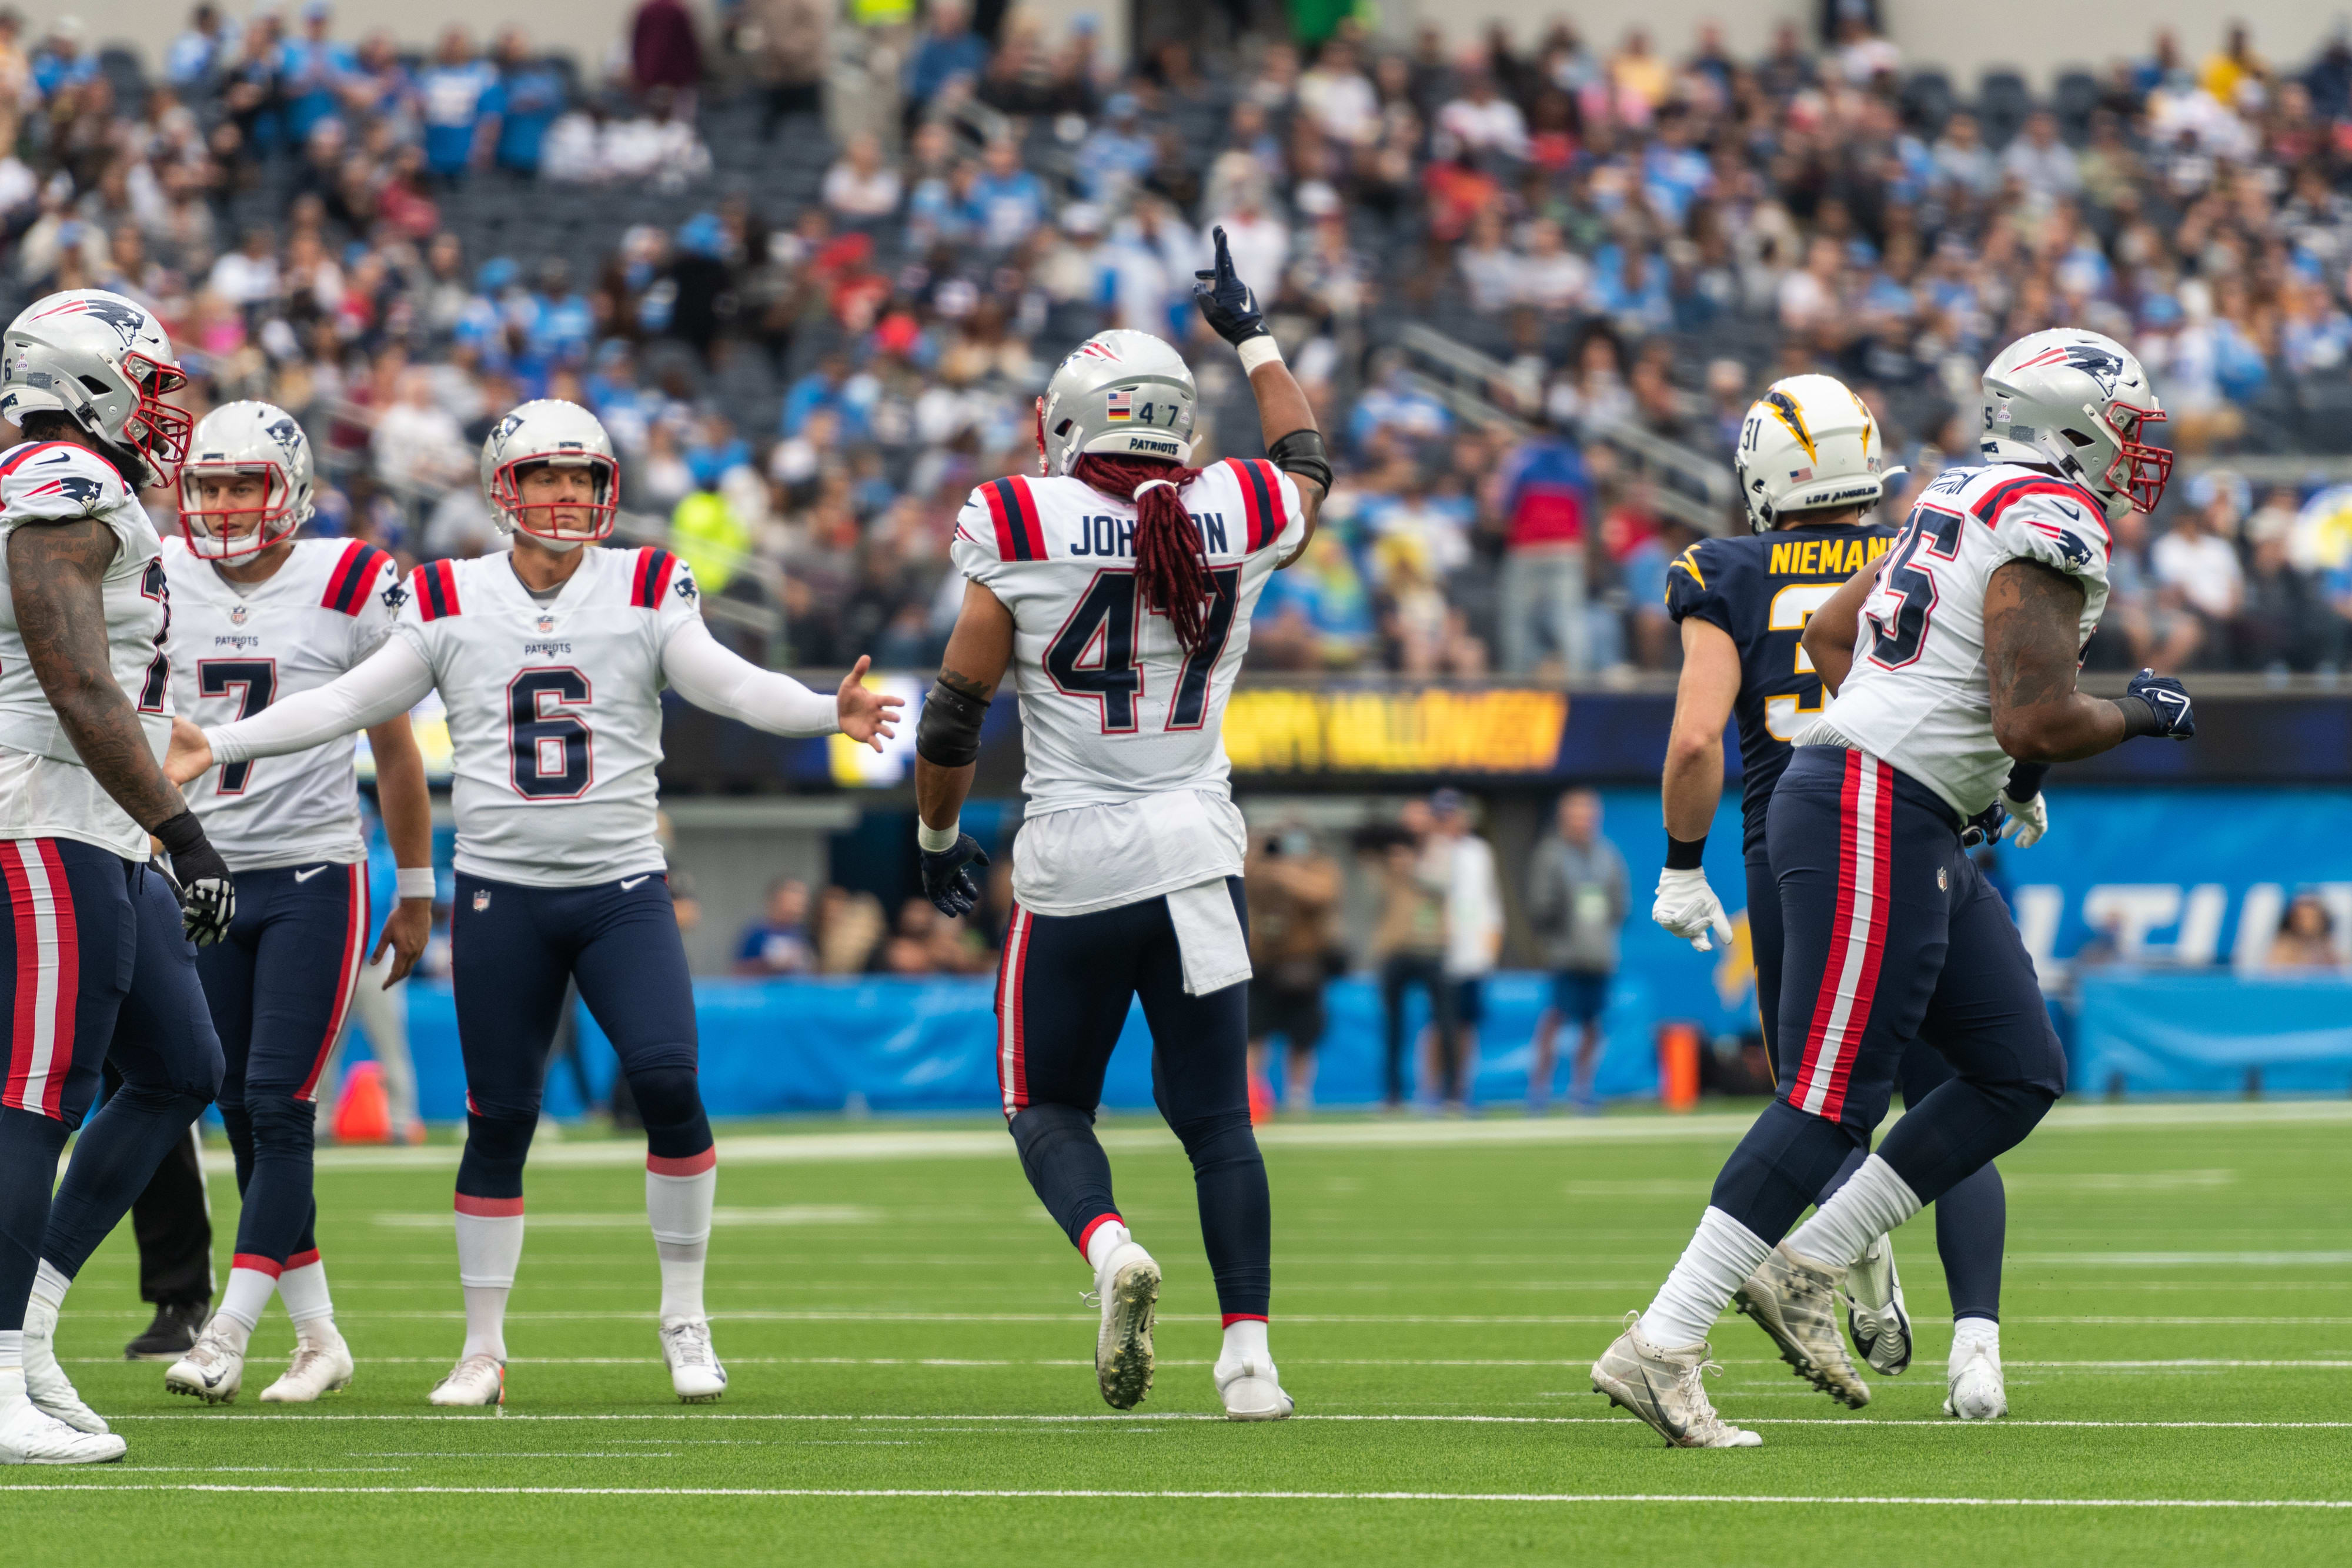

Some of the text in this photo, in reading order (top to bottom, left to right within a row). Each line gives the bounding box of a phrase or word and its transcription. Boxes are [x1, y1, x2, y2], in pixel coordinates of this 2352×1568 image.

[5, 358, 12, 381] 6
[1985, 406, 1993, 430] 5
[1129, 437, 1179, 455] PATRIOTS
[1742, 418, 1762, 452] 31
[1806, 486, 1878, 505] LOS ANGELES
[215, 636, 258, 647] PATRIOTS
[525, 643, 571, 655] PATRIOTS
[1043, 562, 1244, 734] 47
[197, 658, 277, 795] 7
[506, 666, 593, 800] 6
